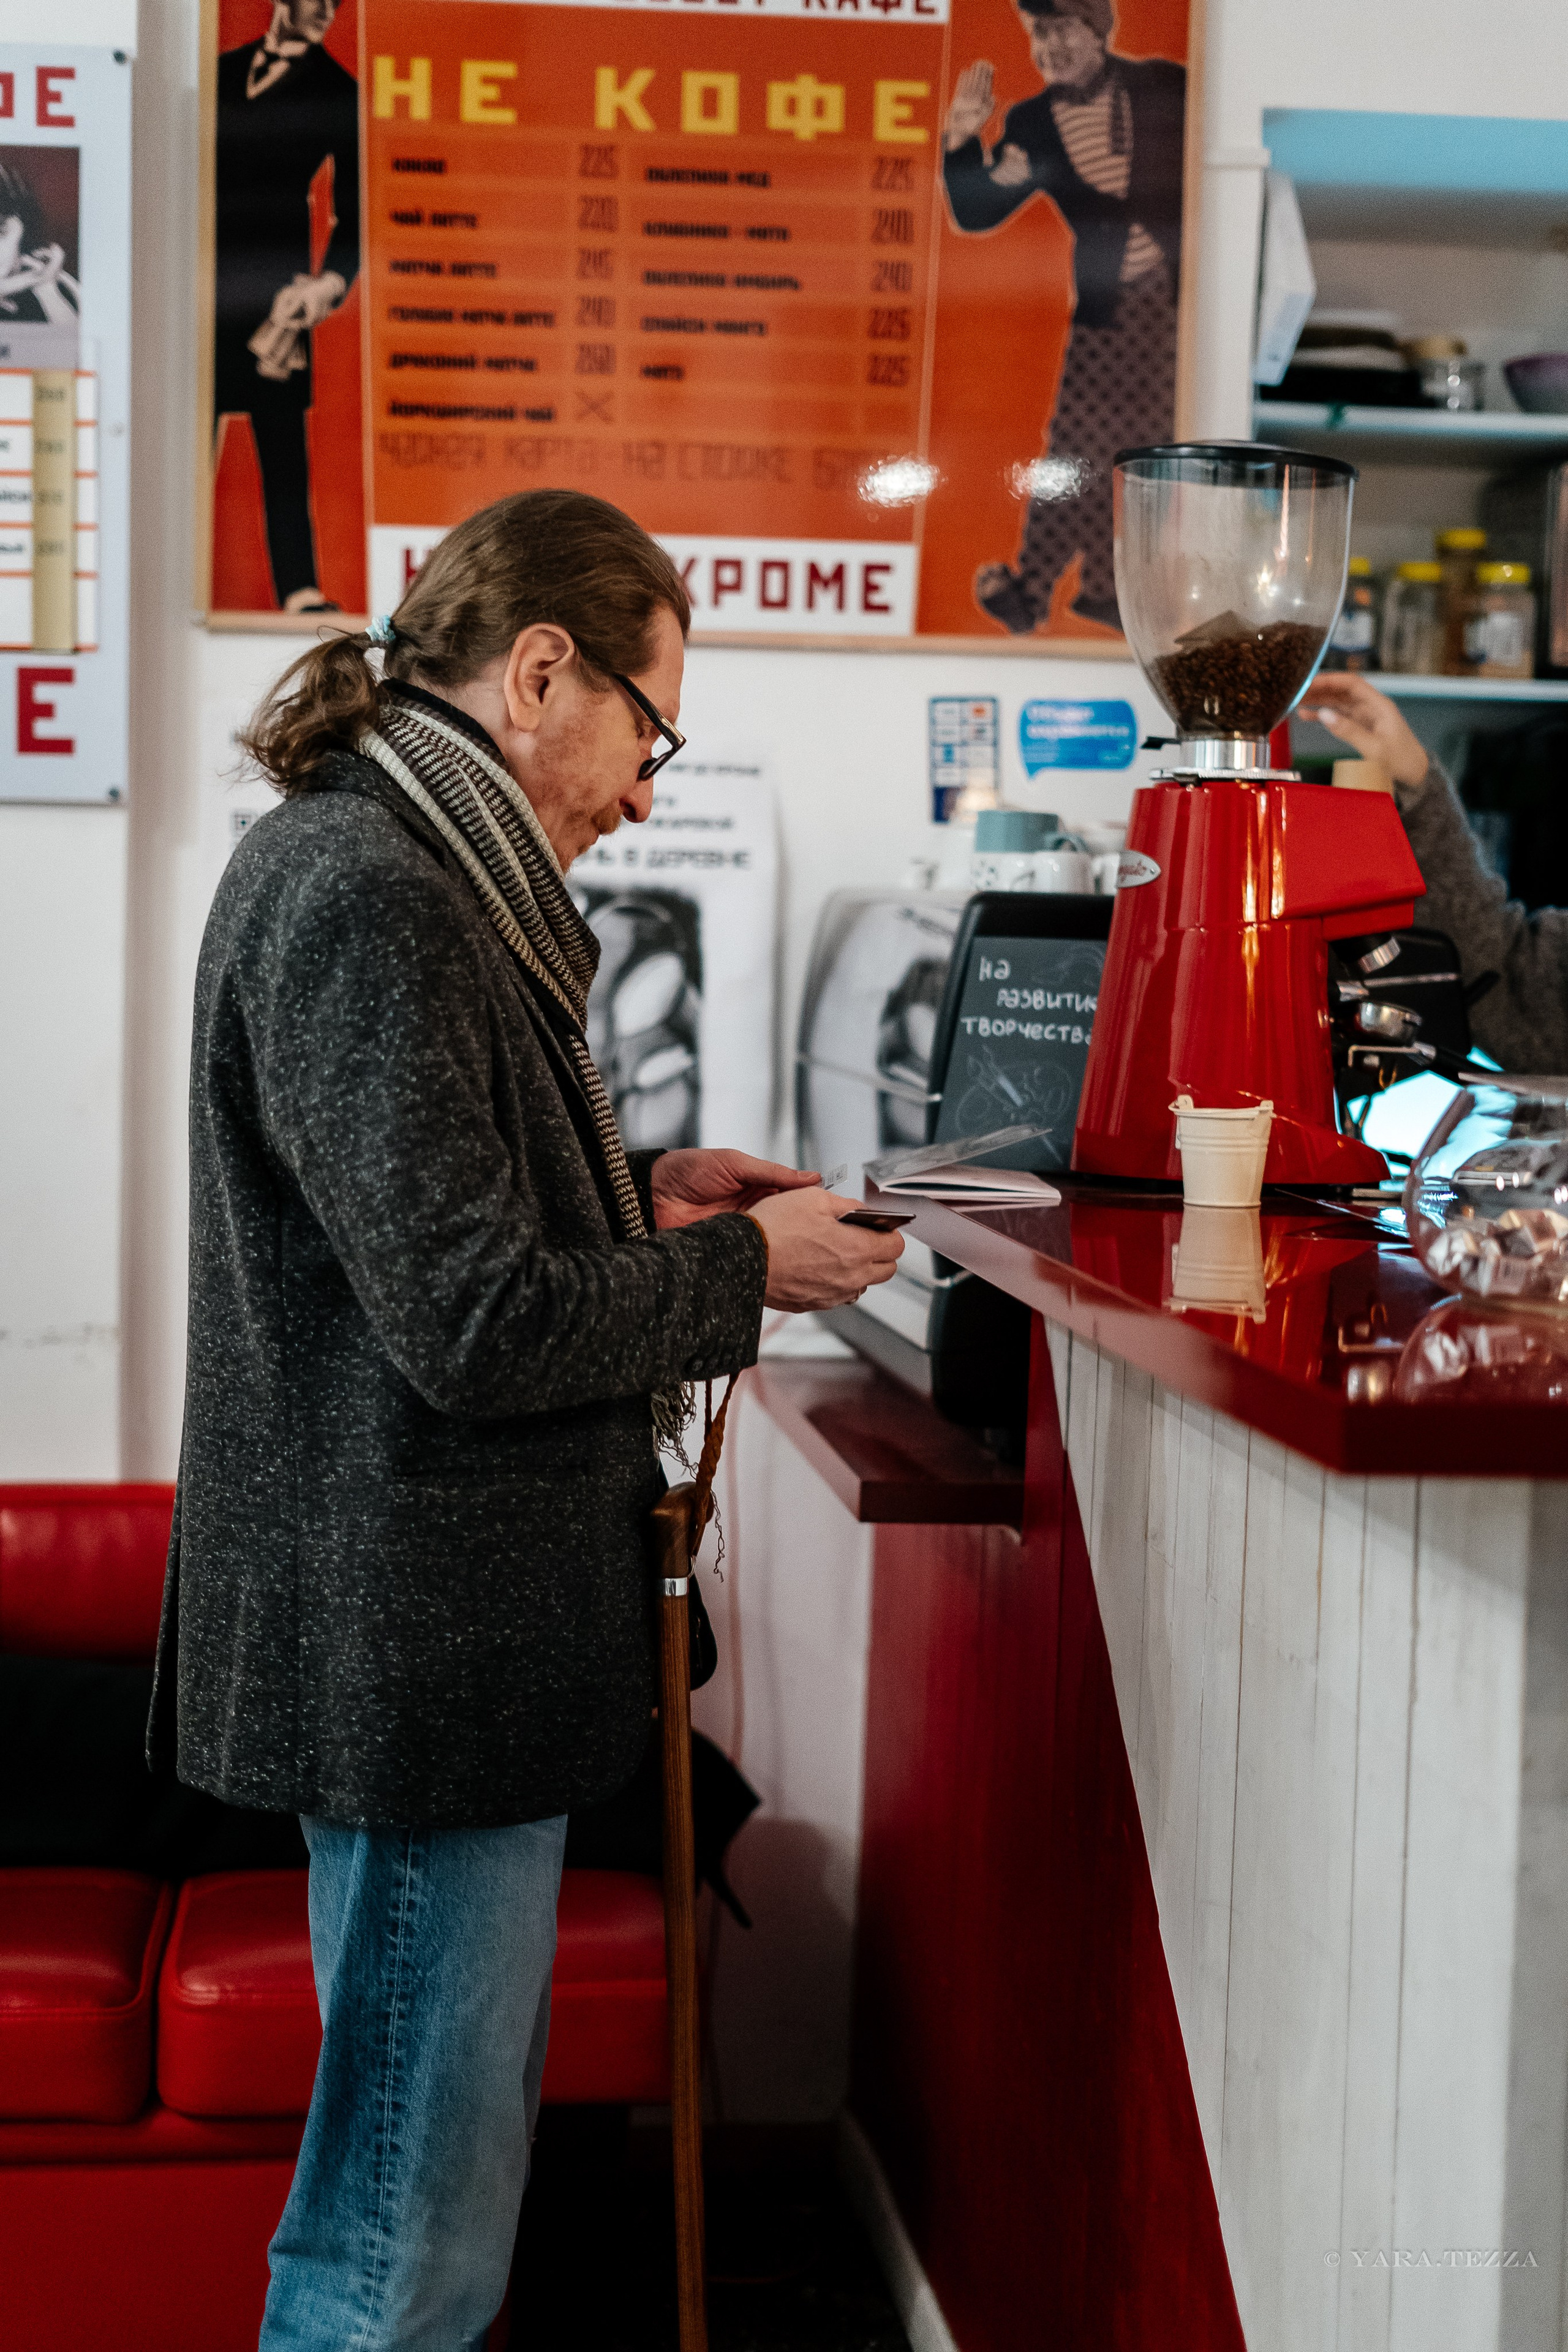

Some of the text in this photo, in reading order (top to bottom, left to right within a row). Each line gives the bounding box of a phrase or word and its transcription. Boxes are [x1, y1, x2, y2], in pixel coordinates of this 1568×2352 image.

[0, 66, 76, 128] Е
[374, 56, 931, 143] НЕ КОФЕ
